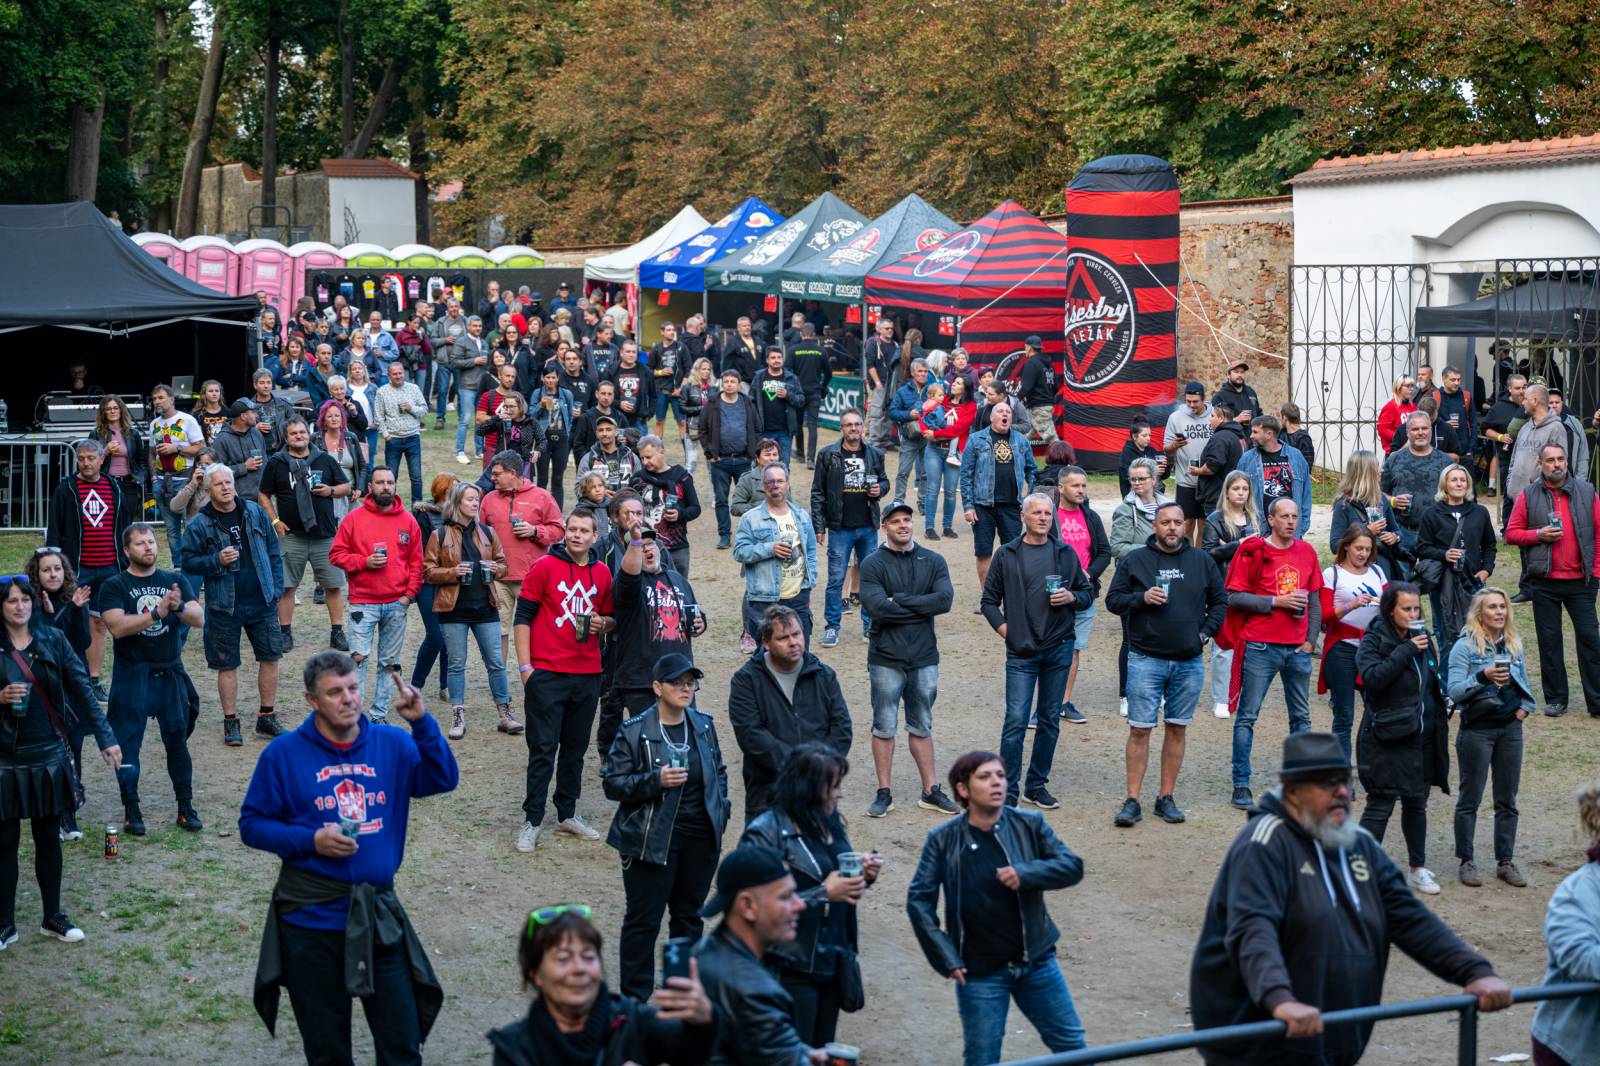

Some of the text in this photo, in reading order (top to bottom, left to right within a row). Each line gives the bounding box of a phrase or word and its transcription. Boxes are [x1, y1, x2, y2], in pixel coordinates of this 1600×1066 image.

[1073, 324, 1114, 344] LEŽÁK
[315, 795, 336, 811] 19
[366, 790, 386, 807] 74
